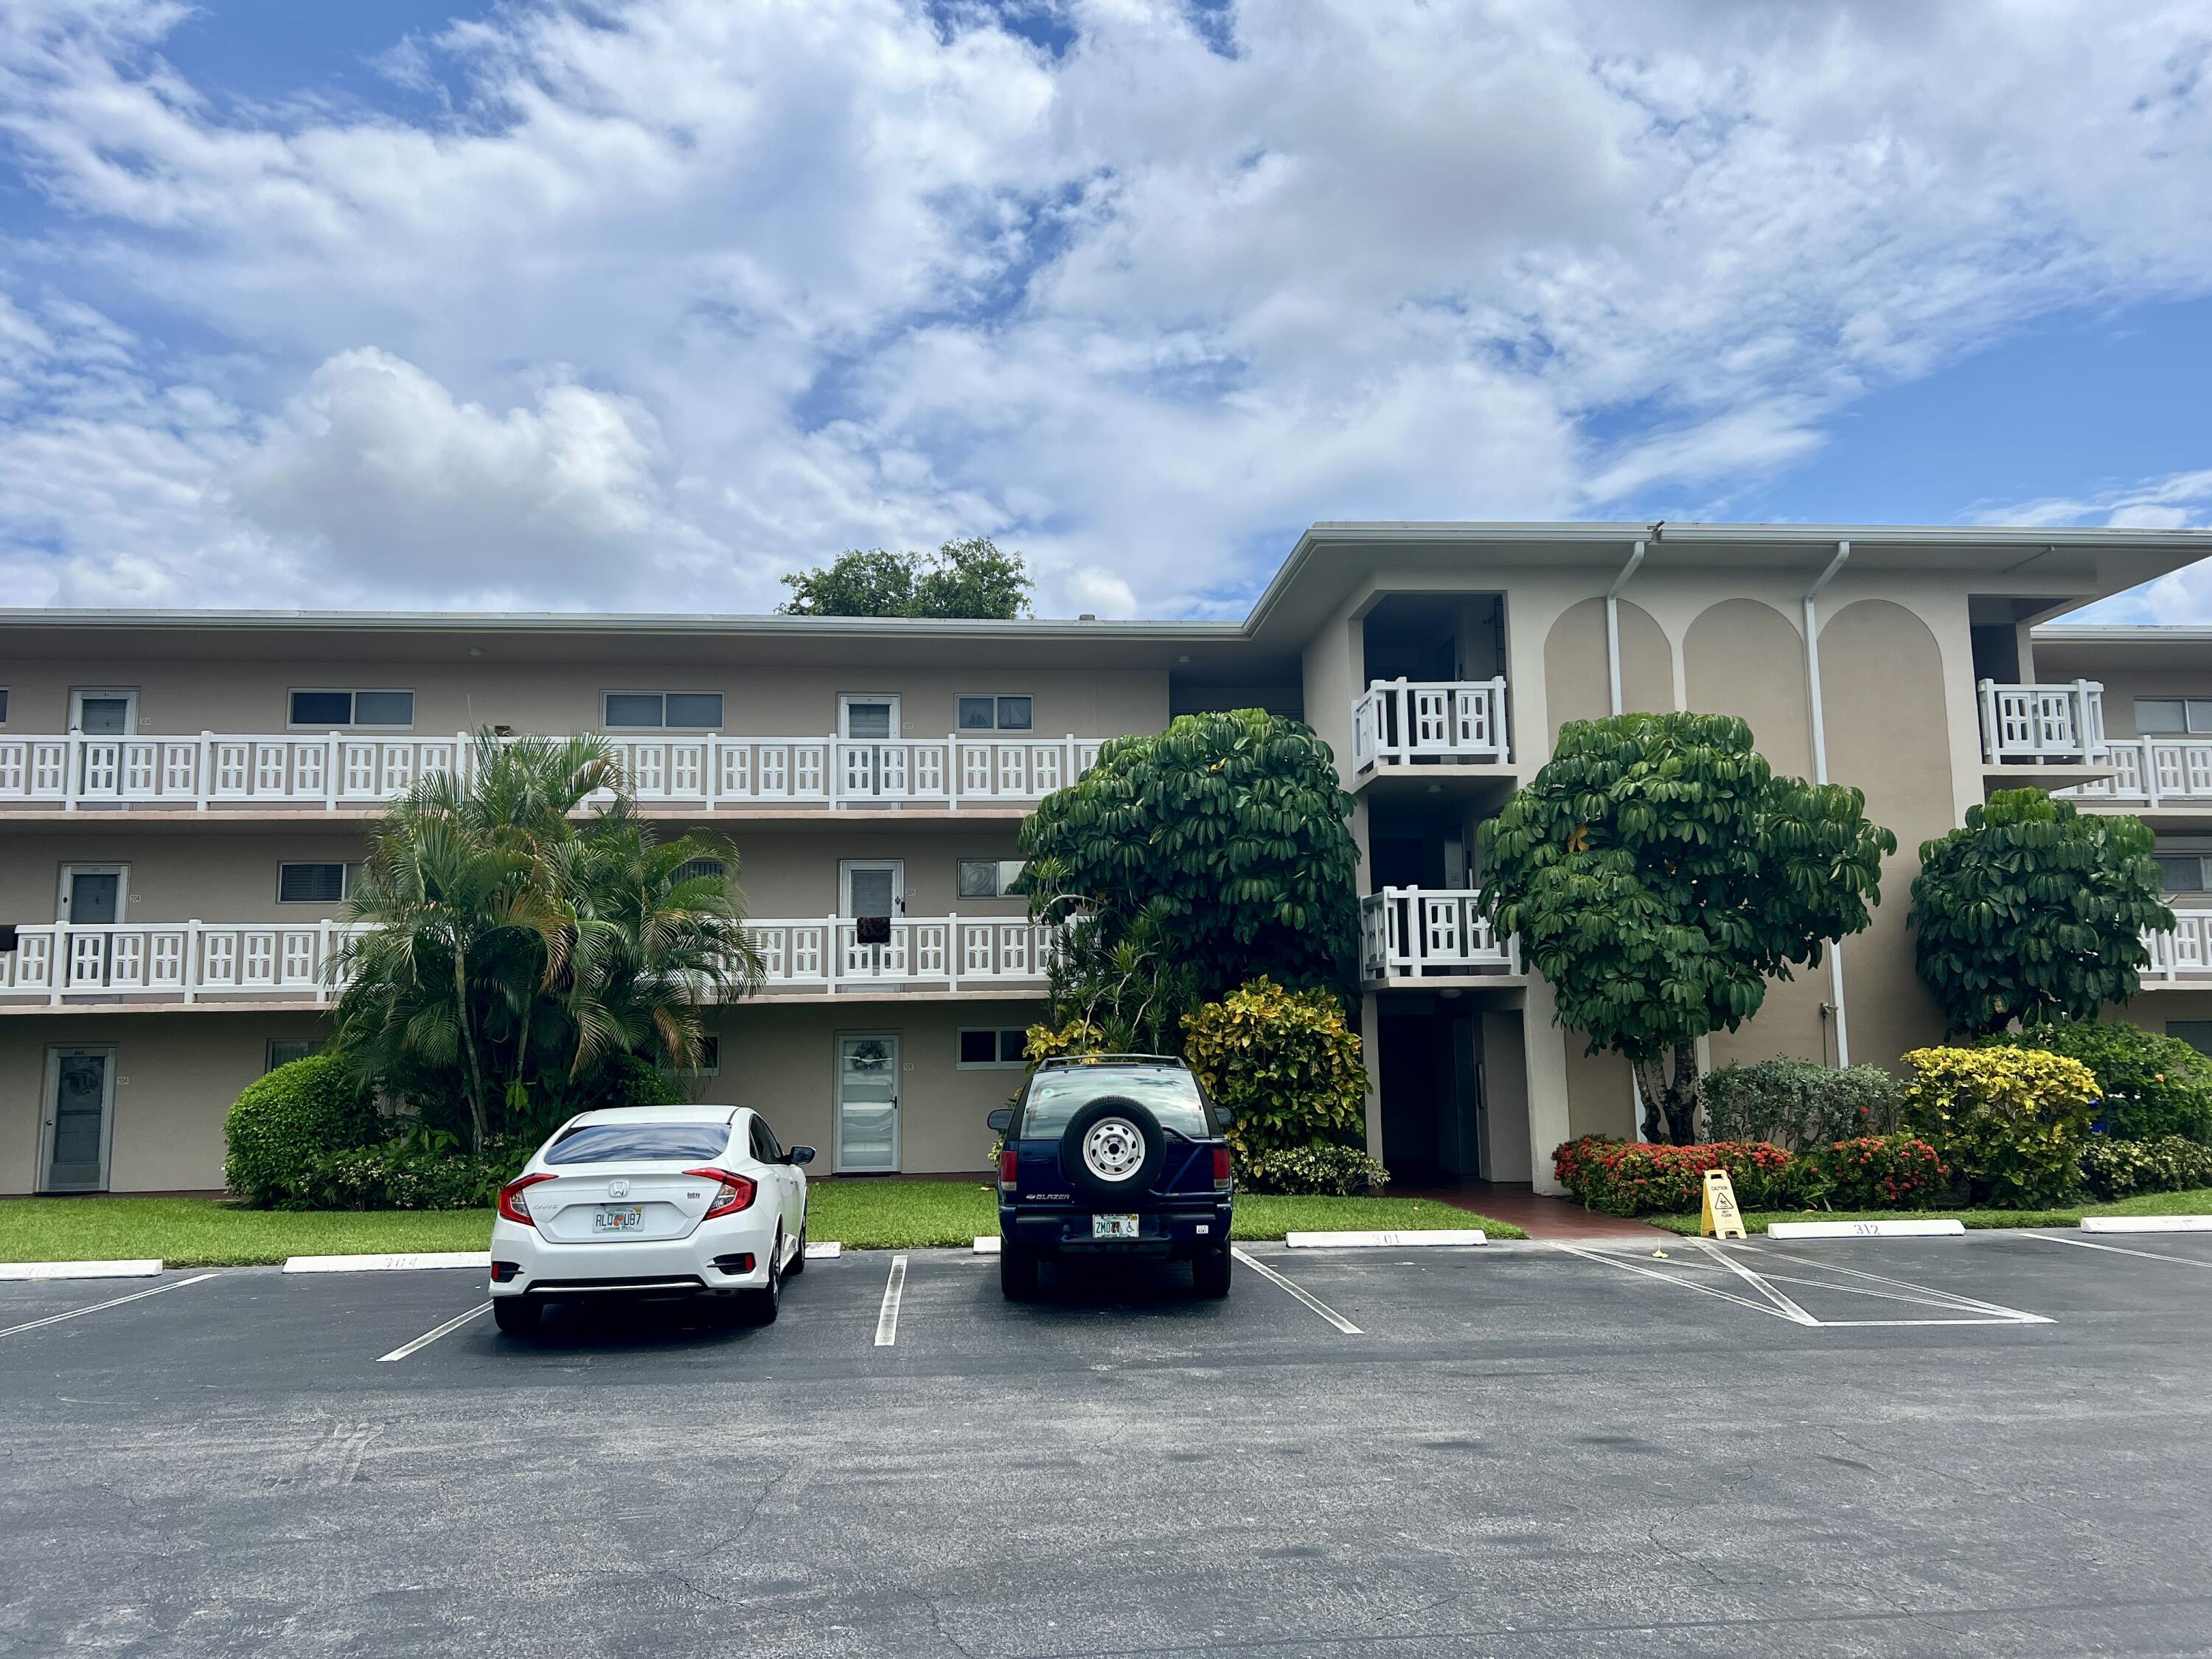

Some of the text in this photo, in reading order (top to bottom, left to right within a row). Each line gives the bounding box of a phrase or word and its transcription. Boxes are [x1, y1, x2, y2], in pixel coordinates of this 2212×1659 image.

[596, 1214, 613, 1226] RLQ
[1854, 1224, 1881, 1235] 312
[1372, 1234, 1399, 1245] 301
